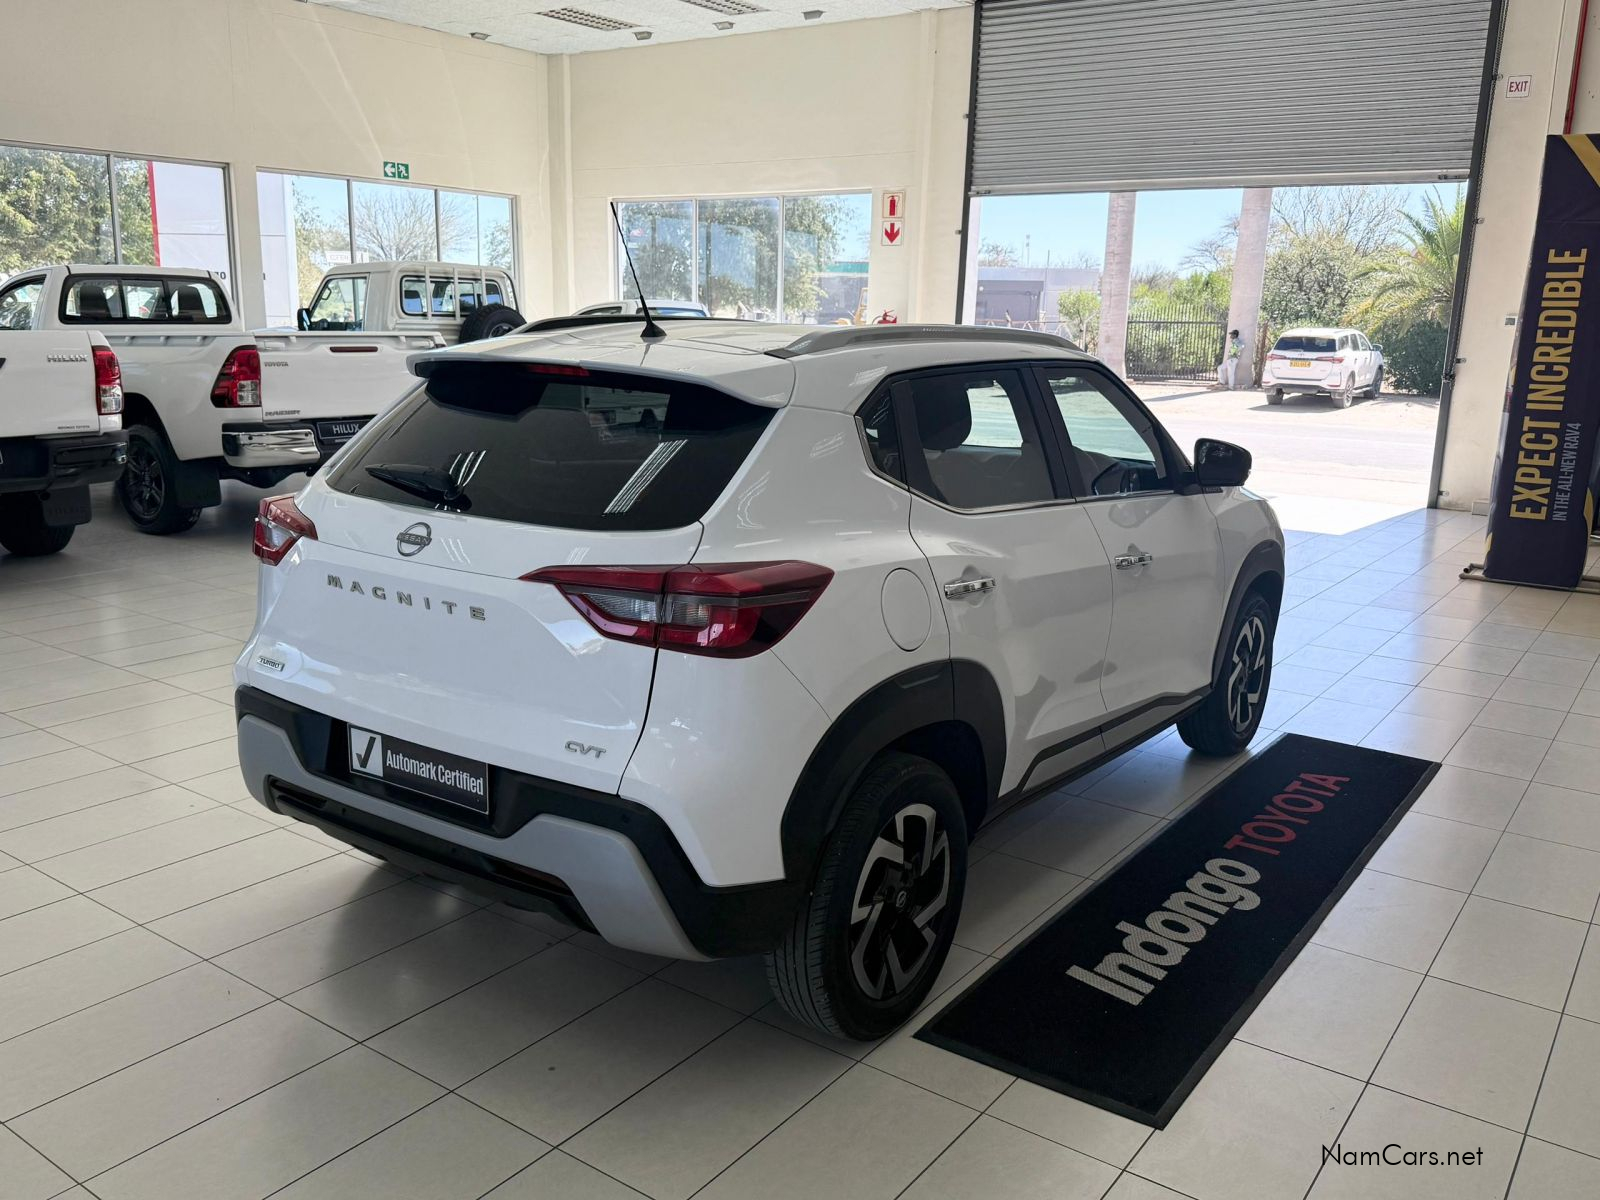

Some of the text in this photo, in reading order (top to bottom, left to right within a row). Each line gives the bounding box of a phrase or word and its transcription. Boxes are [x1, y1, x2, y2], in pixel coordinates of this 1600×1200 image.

[1508, 80, 1528, 93] EXIT
[46, 354, 88, 363] HILUX
[1509, 247, 1588, 521] EXPECT INCREDIBLE
[332, 423, 360, 435] HILUX
[1552, 422, 1582, 521] IN THE ALL-NEW RAV4
[326, 574, 487, 622] MAGNITE
[258, 656, 281, 669] TURBO
[564, 740, 607, 759] CVT
[386, 749, 485, 796] Automark Certified
[1065, 771, 1351, 1007] Indongo TOYOTA
